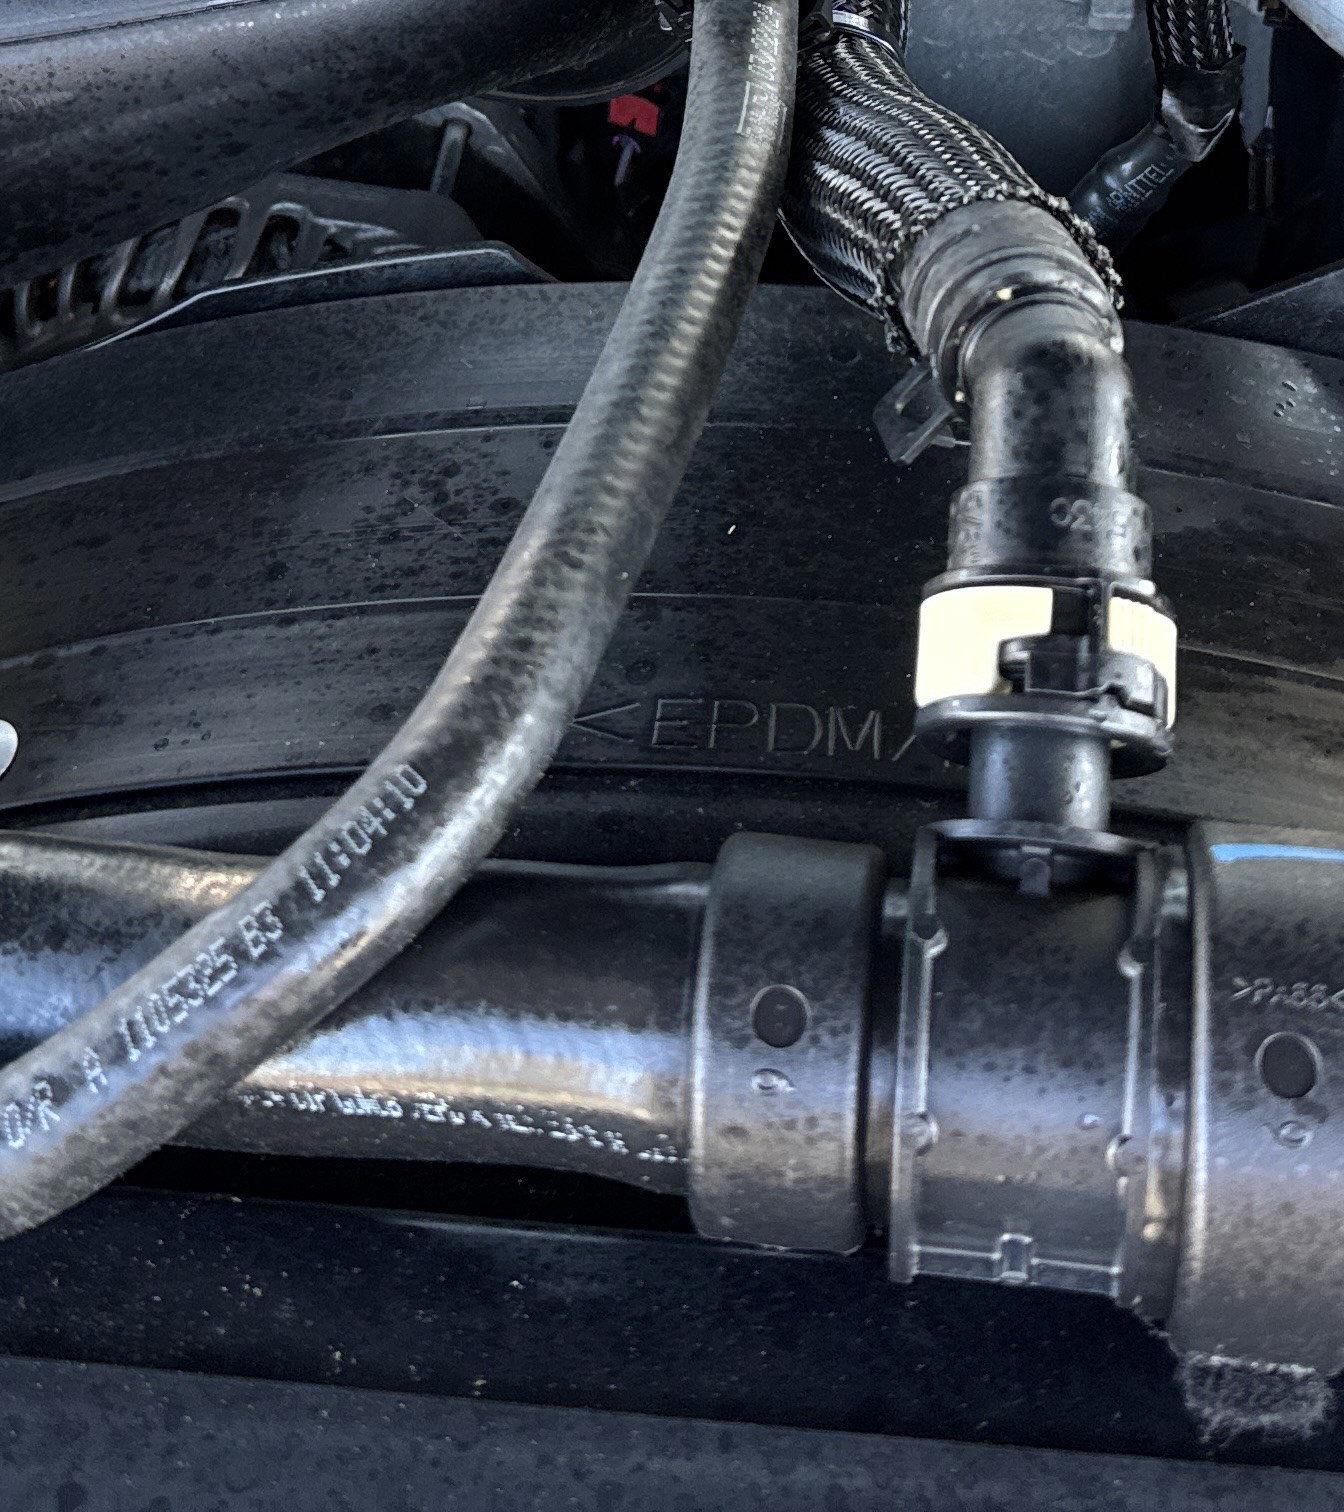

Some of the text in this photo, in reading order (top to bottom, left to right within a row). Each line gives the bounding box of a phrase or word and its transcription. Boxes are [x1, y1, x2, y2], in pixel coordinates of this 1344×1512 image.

[81, 1050, 111, 1095] A
[116, 936, 241, 1064] 1105325
[237, 902, 286, 962] B3
[299, 762, 429, 904] 11:04:10
